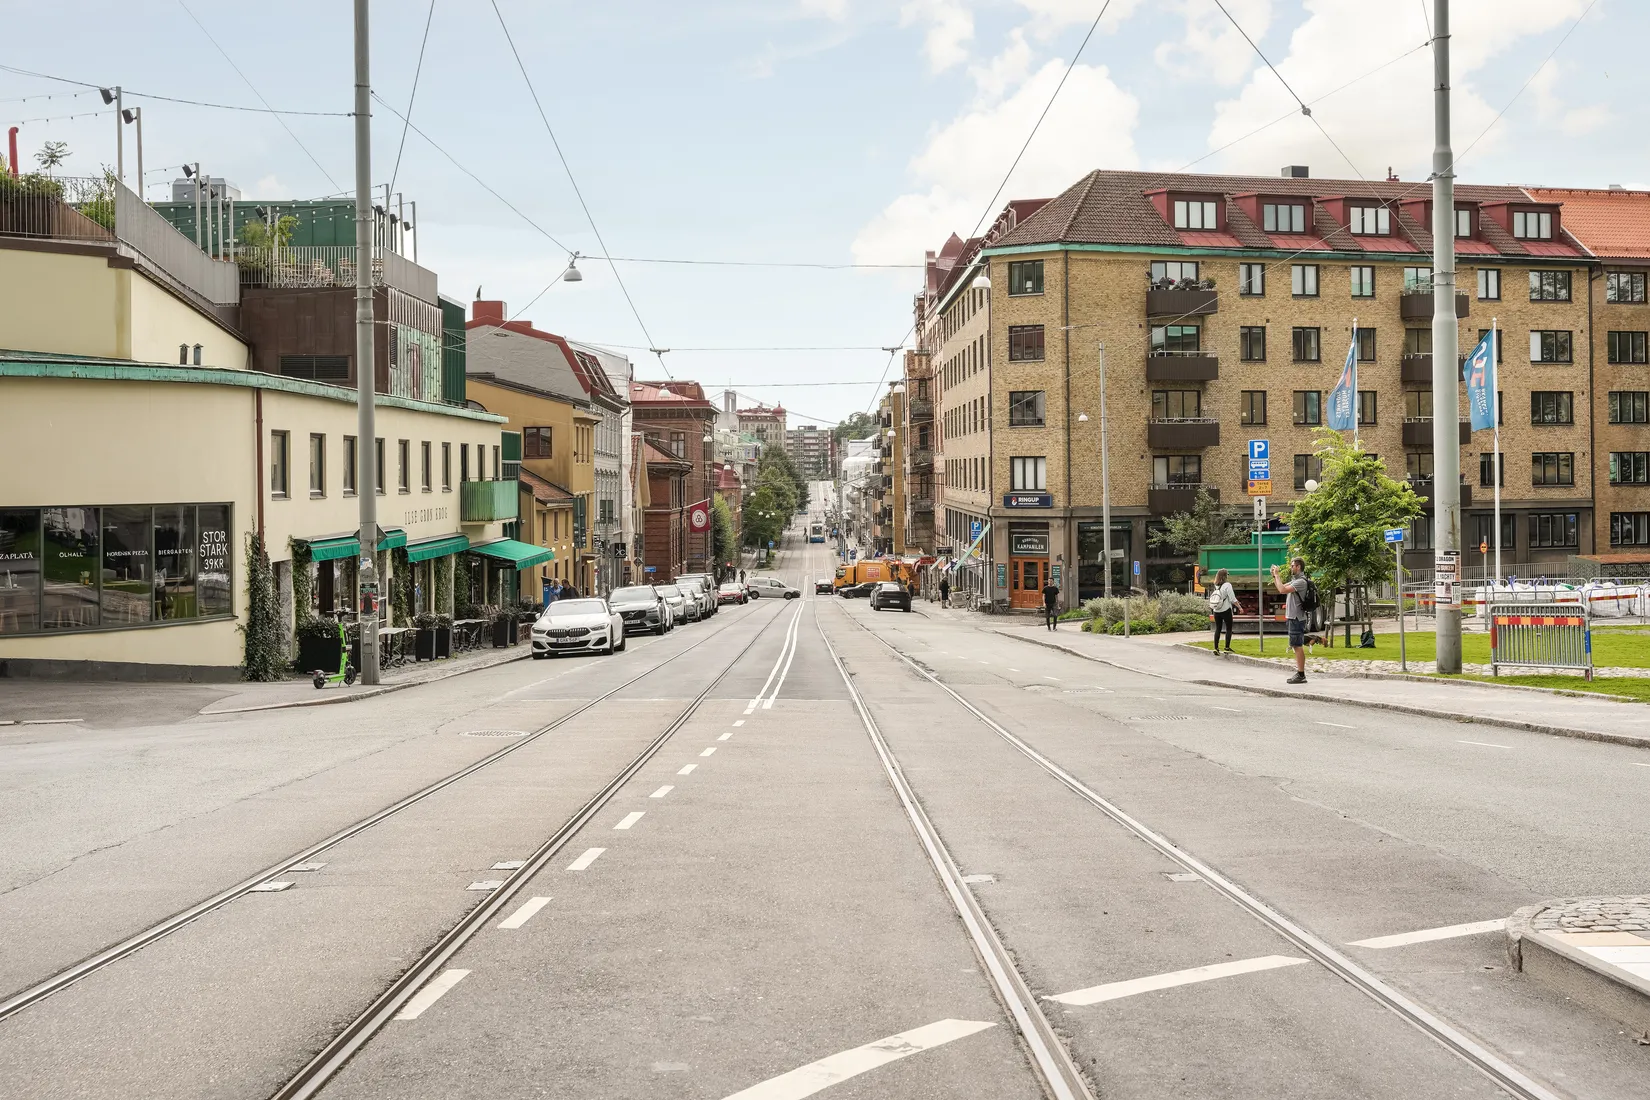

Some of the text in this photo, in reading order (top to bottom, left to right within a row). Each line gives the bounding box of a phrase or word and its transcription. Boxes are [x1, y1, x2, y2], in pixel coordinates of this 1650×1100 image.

[1254, 442, 1266, 458] P
[973, 522, 980, 530] P
[203, 530, 226, 543] STOR
[158, 548, 193, 556] BIERGARTEN
[200, 543, 228, 557] STARK
[204, 558, 224, 570] 39KR
